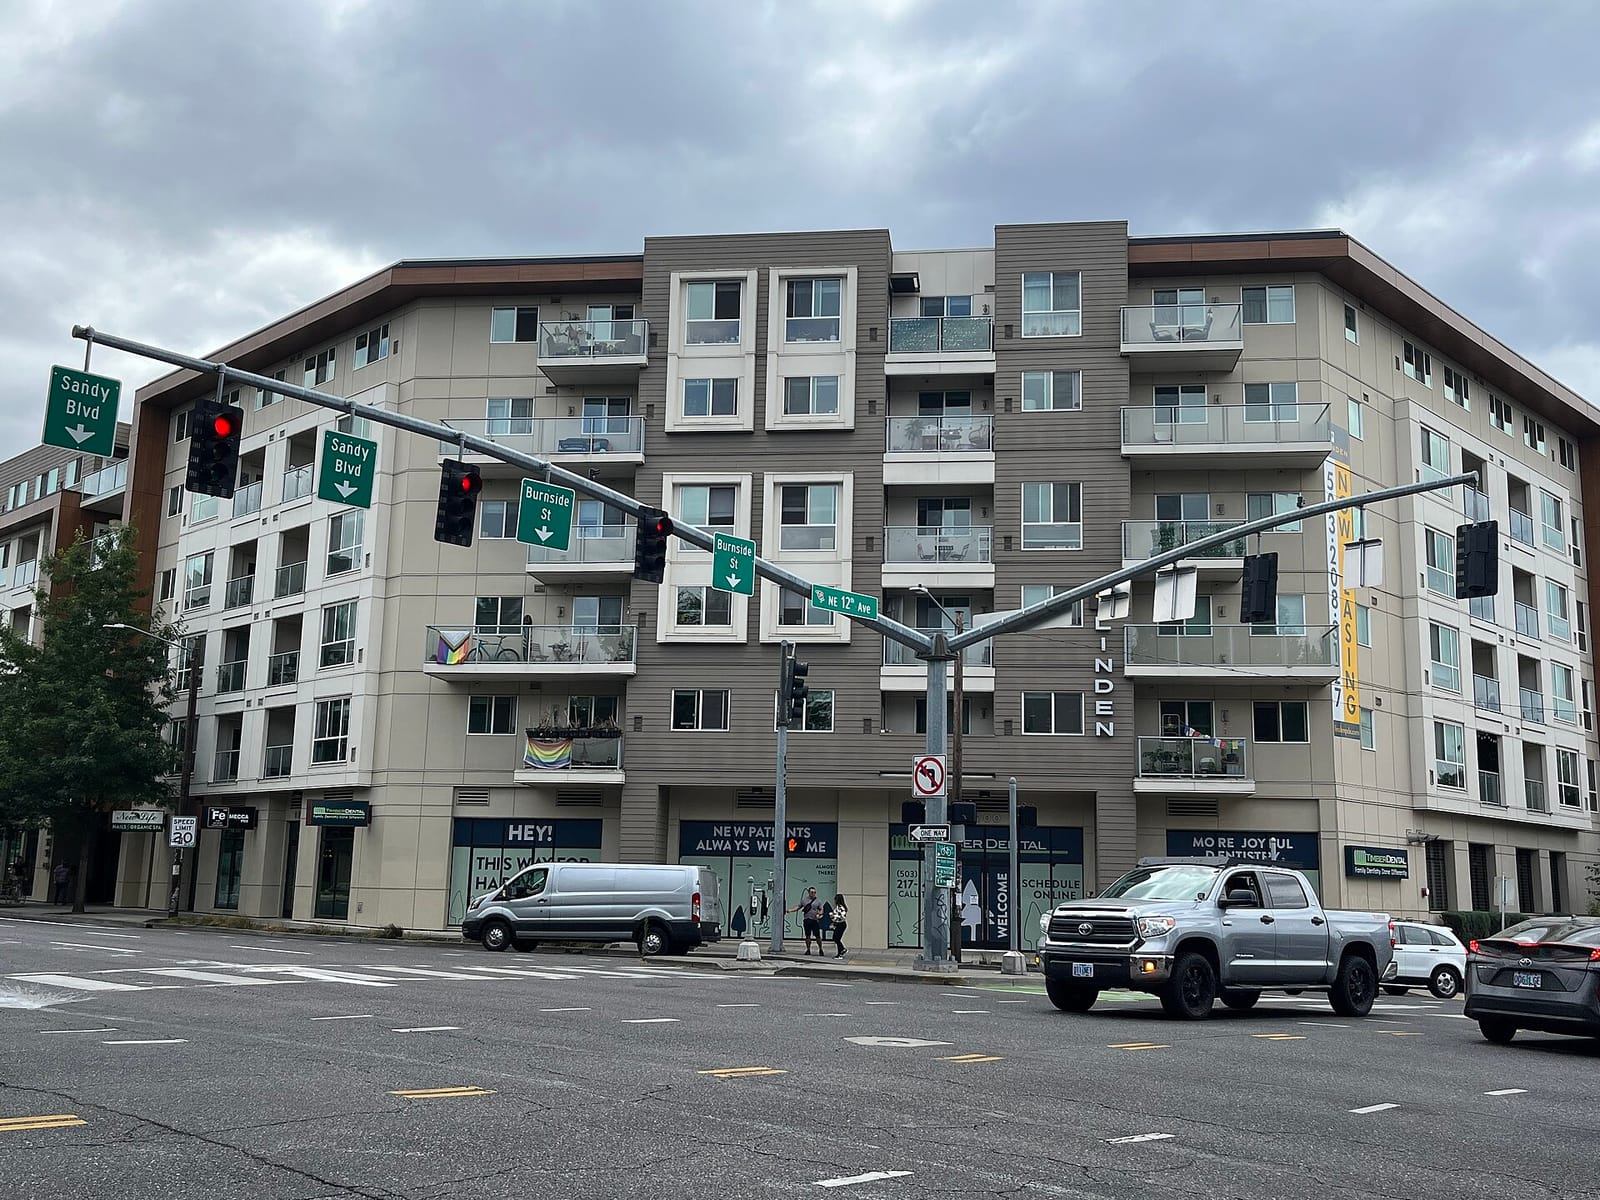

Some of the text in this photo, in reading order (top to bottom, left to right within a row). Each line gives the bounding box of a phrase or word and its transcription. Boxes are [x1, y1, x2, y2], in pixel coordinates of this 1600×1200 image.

[61, 375, 110, 403] Sandy
[66, 399, 100, 420] Blvd
[331, 438, 369, 462] Sandy
[335, 459, 361, 477] Blvd
[525, 486, 570, 508] Burnside
[541, 508, 551, 521] St
[717, 538, 752, 557] Burnside
[729, 558, 738, 570] St
[828, 596, 838, 607] NE
[857, 602, 871, 614] Ave
[1343, 589, 1356, 715] ASING
[1095, 616, 1114, 737] LINDEN
[212, 810, 226, 820] Fe
[172, 832, 193, 844] 20
[508, 824, 552, 841] HEY!
[713, 826, 811, 838] NEW PATINTS
[696, 840, 826, 853] ALWAYS WEME
[986, 839, 1047, 850] DETAL
[1192, 837, 1293, 849] MORE JOYUL
[476, 857, 511, 870] THIS
[896, 869, 918, 878] (503)
[1022, 879, 1080, 889] SCHEDULE
[1033, 891, 1076, 900] ONLINE
[997, 873, 1008, 938] WELCOME
